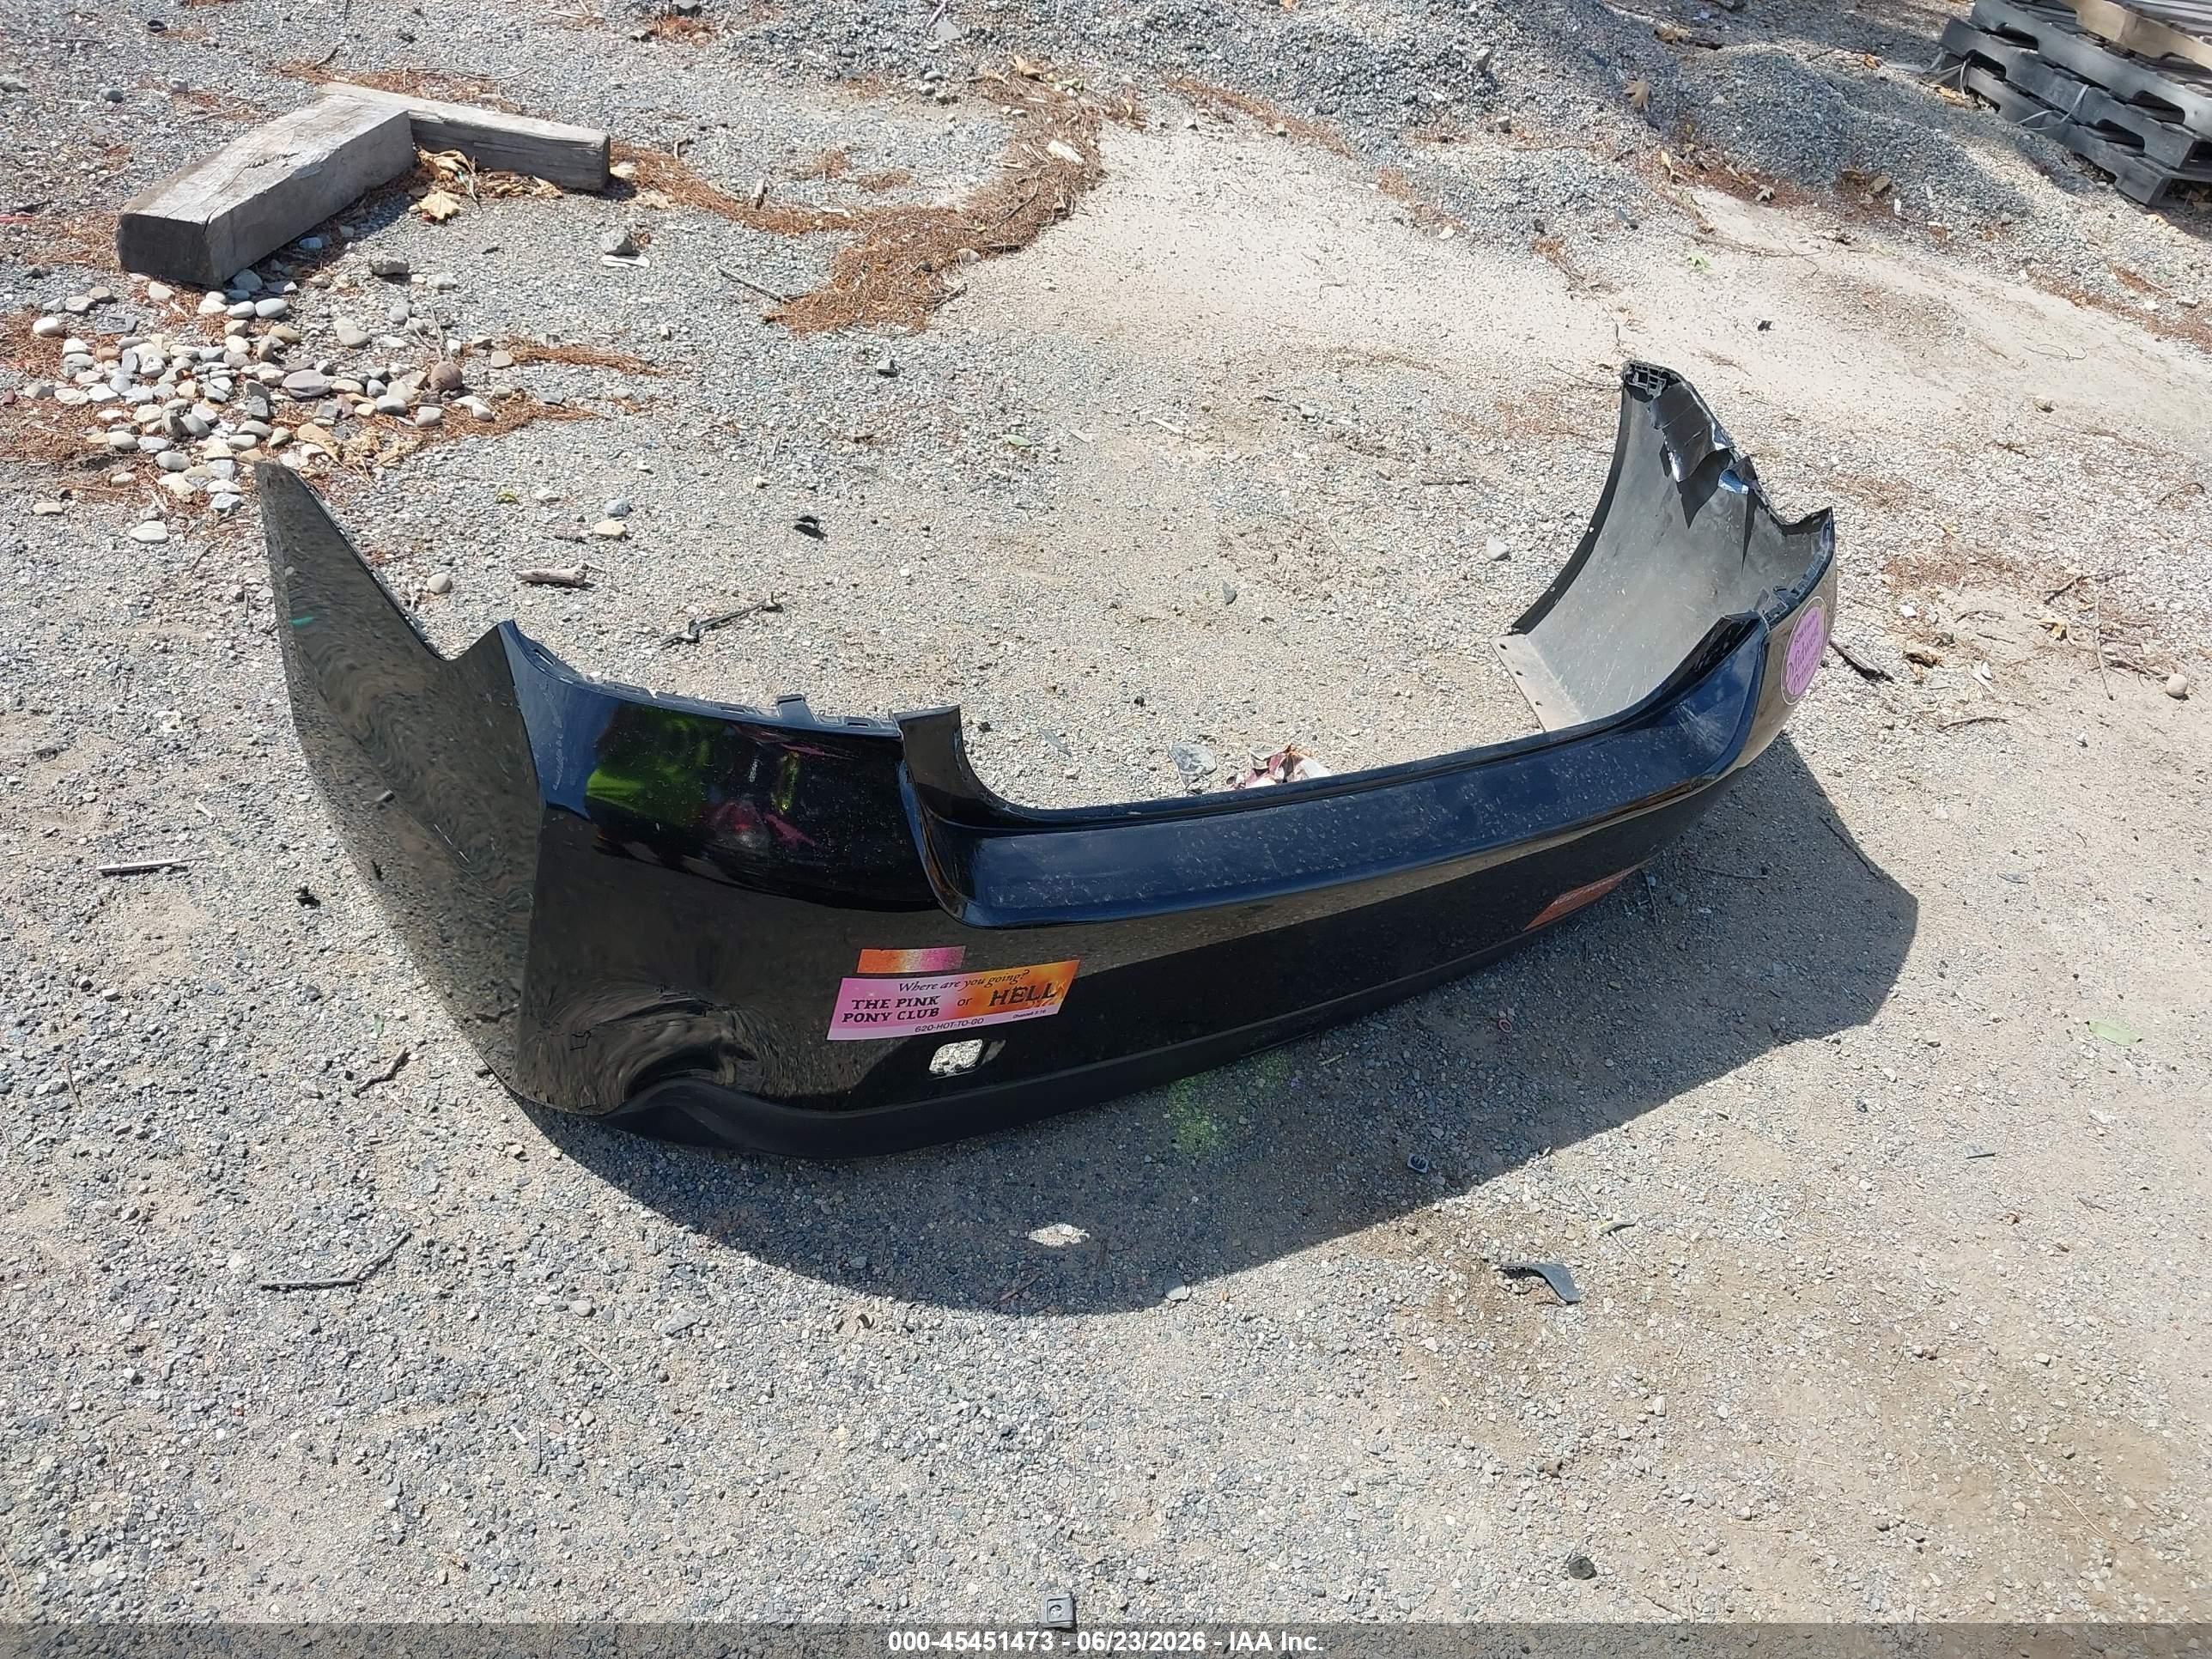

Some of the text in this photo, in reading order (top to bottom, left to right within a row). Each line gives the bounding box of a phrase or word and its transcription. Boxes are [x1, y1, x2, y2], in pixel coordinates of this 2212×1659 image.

[898, 969, 1030, 993] Where are you going?
[957, 997, 973, 1006] or
[988, 982, 1057, 1006] HELL
[852, 995, 941, 1010] THE PINK
[842, 1007, 939, 1023] PONY CLUB
[915, 1018, 984, 1032] 620-HOT-TO-GO
